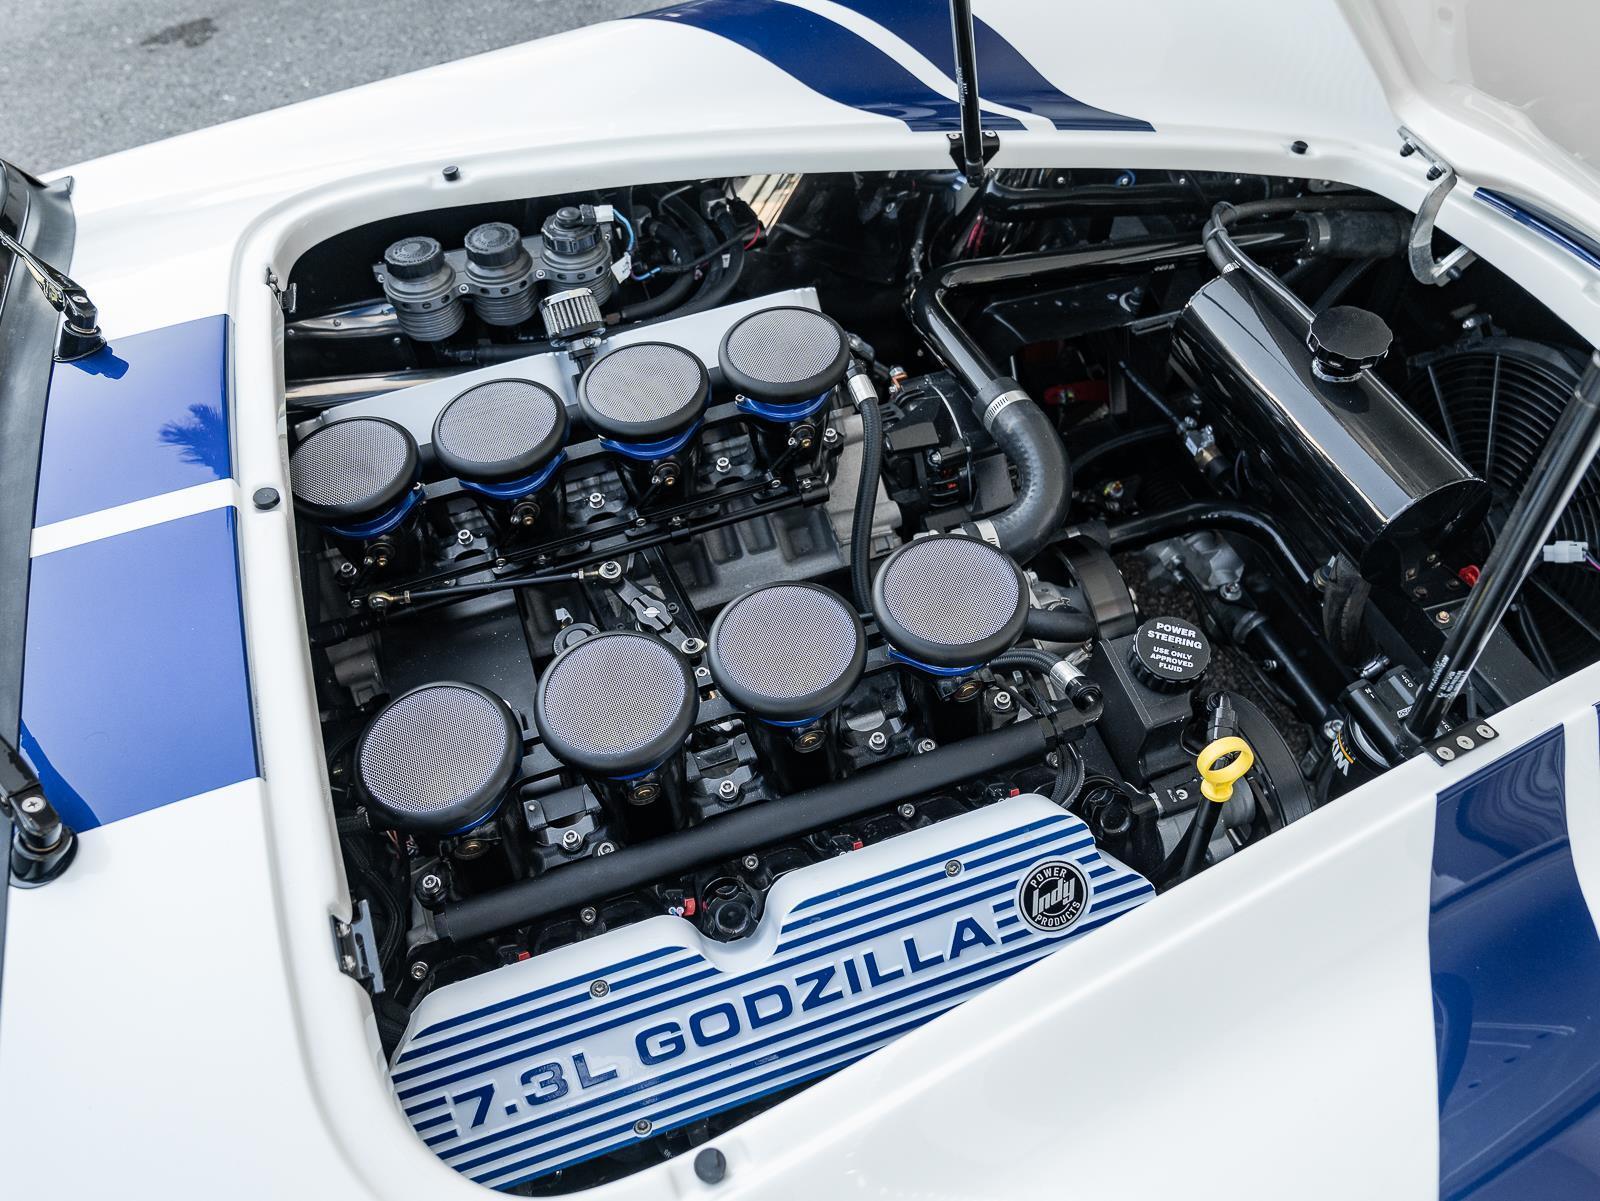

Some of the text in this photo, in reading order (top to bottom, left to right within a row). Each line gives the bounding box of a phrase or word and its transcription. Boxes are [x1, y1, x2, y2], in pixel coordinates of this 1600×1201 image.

[1147, 630, 1202, 649] STEERING
[1156, 622, 1196, 638] POWER
[1150, 653, 1194, 668] APPROVED
[1153, 646, 1192, 660] USE ONLY
[1158, 662, 1182, 672] FLUID
[1030, 867, 1067, 888] POWER
[1032, 877, 1075, 917] Indy
[1034, 901, 1081, 927] PRODUCTS
[456, 916, 997, 1130] 7.3L GODZILLA
